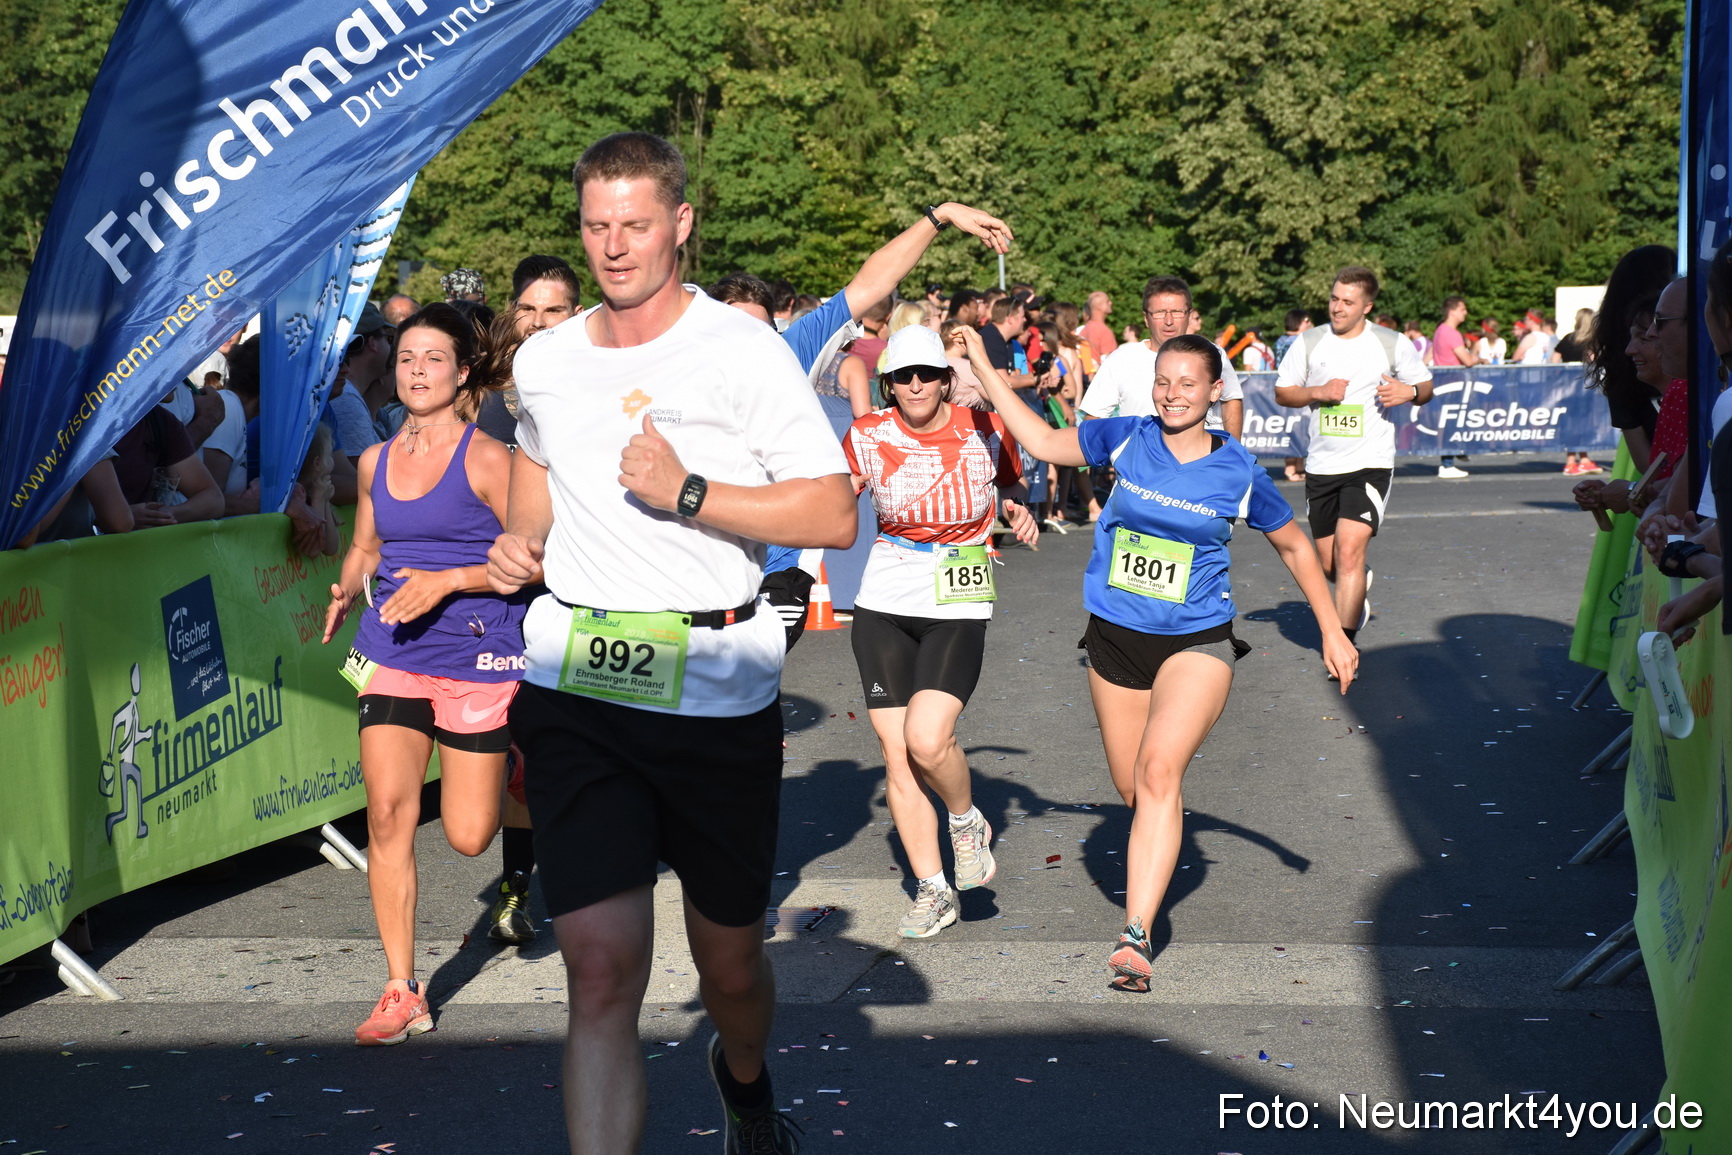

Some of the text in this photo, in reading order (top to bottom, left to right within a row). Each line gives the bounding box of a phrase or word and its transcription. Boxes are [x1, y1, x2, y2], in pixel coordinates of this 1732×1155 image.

[340, 43, 435, 128] Druck
[11, 269, 237, 509] www.frischmann-net.de
[649, 415, 682, 424] UMARKT
[1324, 414, 1358, 428] 1145
[1438, 402, 1567, 429] Fischer
[1449, 428, 1556, 442] AUTOMOBILE
[1120, 478, 1217, 517] energiegeladen
[944, 565, 991, 588] 1851
[1121, 552, 1177, 584] 1801
[950, 586, 974, 594] Mederer
[1127, 575, 1166, 590] Lehner Tanja
[176, 620, 211, 653] Fischer
[182, 641, 211, 664] AUTOMOBILE
[588, 636, 655, 677] 992
[572, 678, 608, 689] Landratsamt
[608, 683, 639, 694] Neumarkt
[575, 668, 665, 690] Ehrnsberger Roland
[152, 655, 283, 791] firmenlauf
[157, 768, 218, 825] neumarkt
